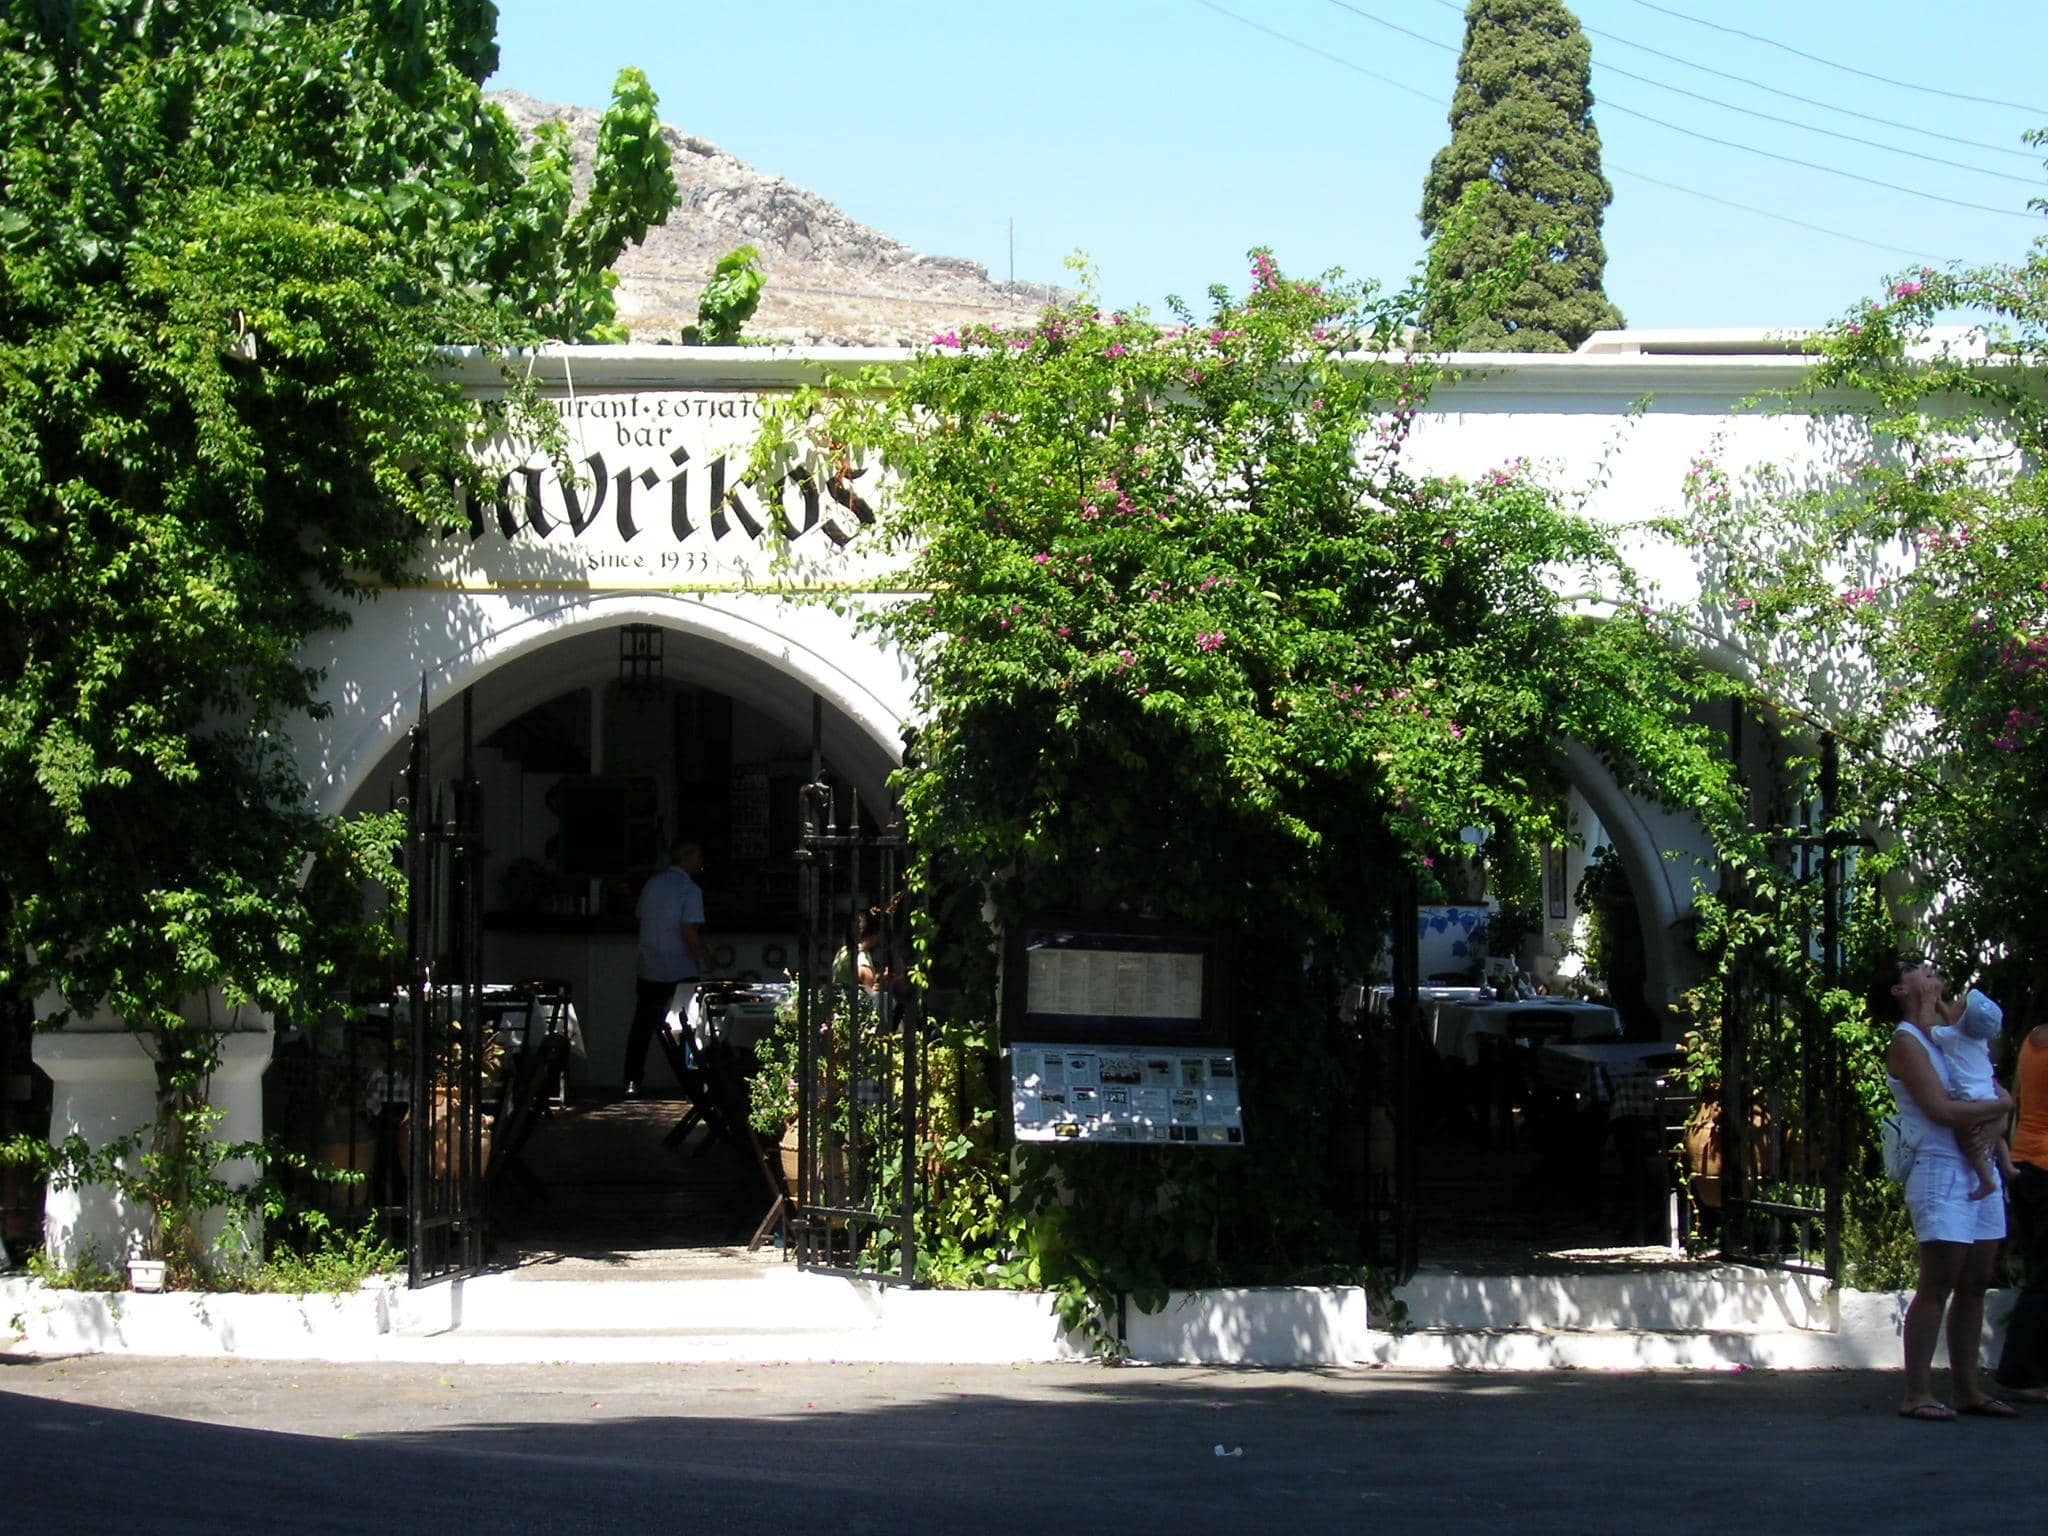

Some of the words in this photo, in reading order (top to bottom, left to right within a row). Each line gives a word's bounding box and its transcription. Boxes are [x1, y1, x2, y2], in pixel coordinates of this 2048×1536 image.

[482, 396, 638, 418] reurant
[617, 421, 672, 447] bar
[588, 550, 645, 570] since
[661, 552, 708, 574] 1933
